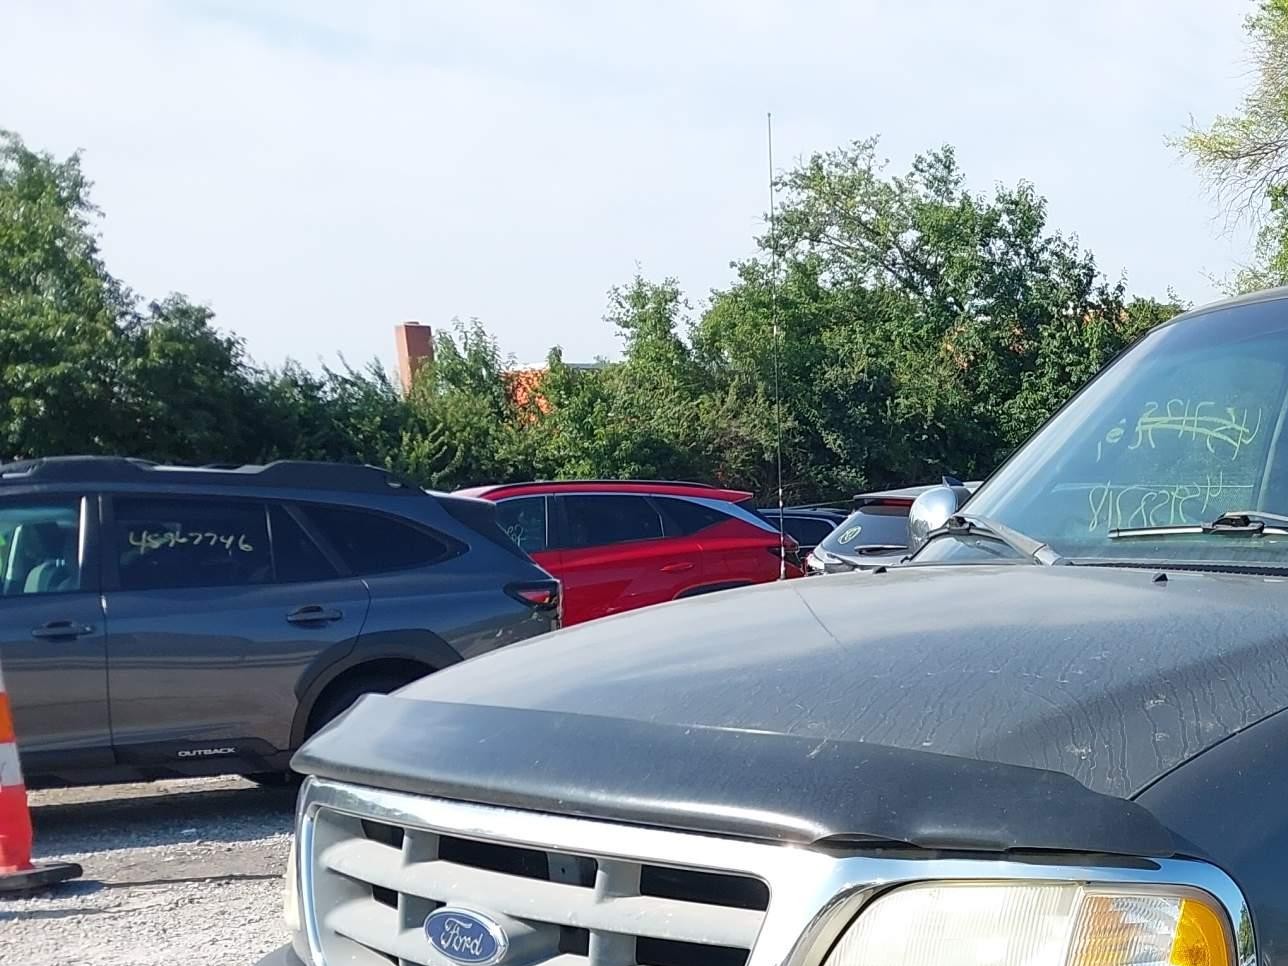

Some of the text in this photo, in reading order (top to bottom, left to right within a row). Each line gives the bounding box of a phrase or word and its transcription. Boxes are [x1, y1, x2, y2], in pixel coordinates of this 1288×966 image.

[129, 530, 253, 556] 45967746
[177, 747, 236, 758] OUTBACK
[440, 917, 484, 957] Ford
